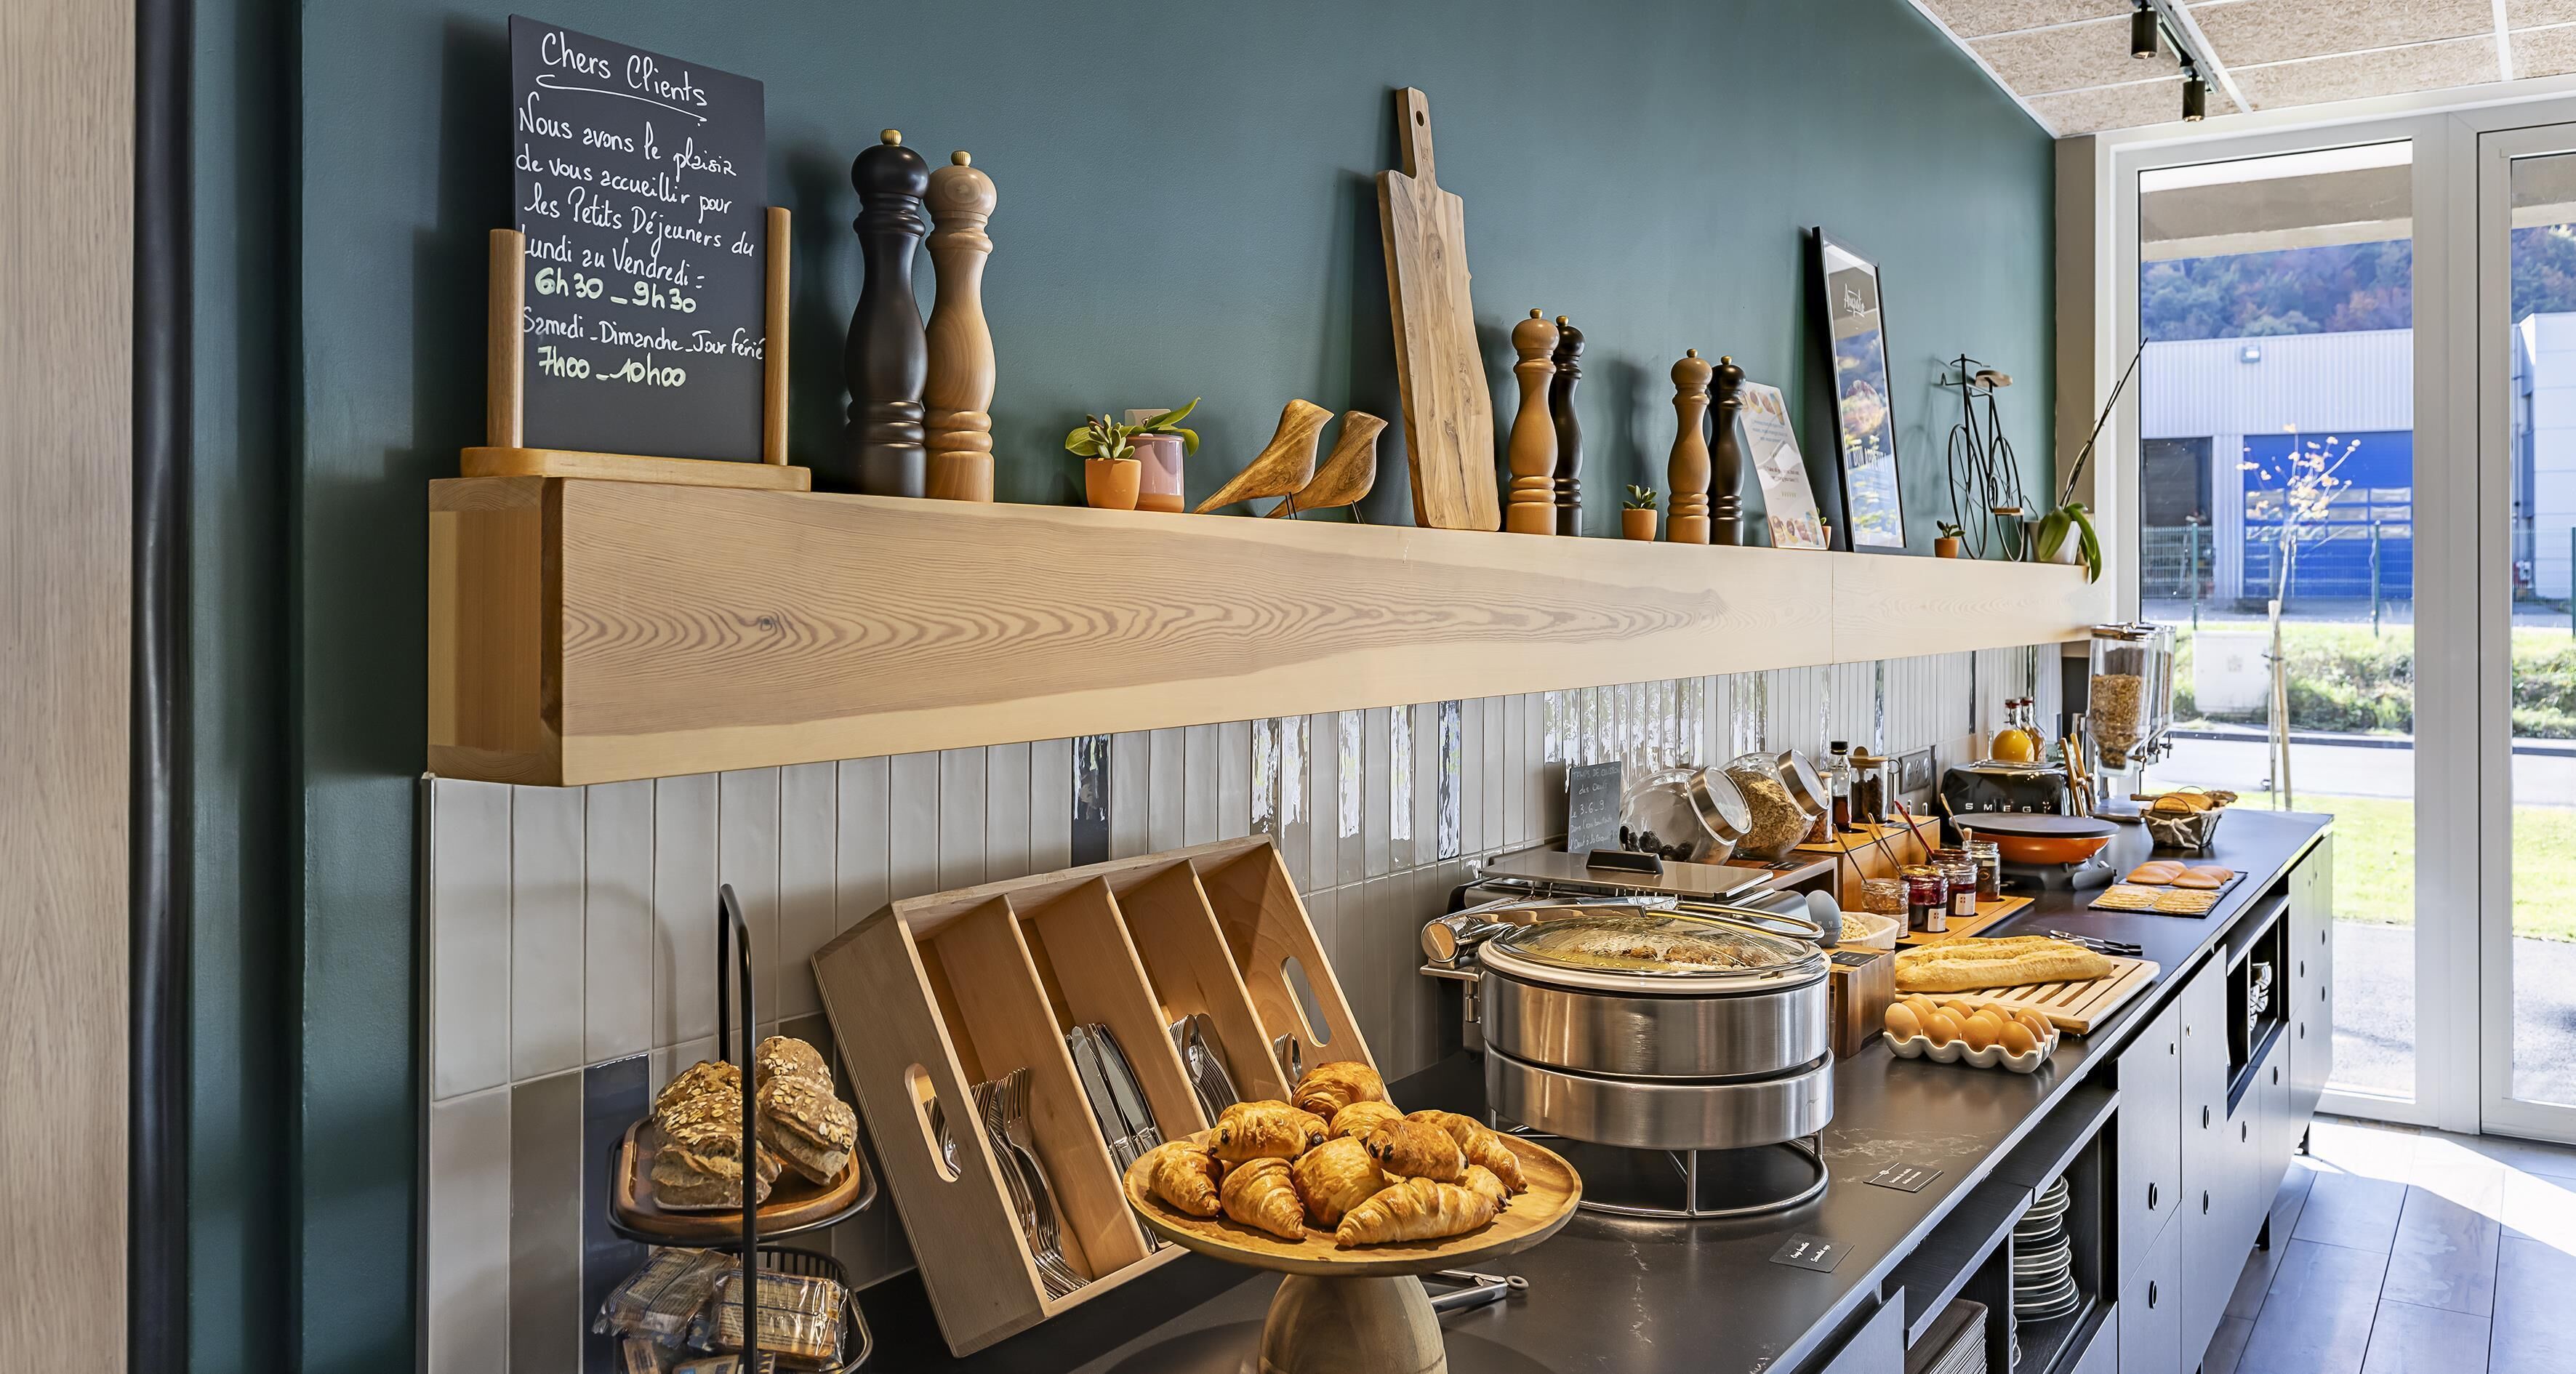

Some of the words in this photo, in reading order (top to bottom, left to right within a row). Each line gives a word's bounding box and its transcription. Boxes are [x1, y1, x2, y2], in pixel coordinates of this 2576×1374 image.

[542, 31, 611, 79] Chers
[627, 55, 707, 107] Clients
[519, 91, 573, 139] Nous
[582, 126, 635, 153] avons
[644, 121, 661, 161] le
[516, 143, 543, 172] de
[548, 159, 593, 181] vous
[601, 170, 691, 205] accueillir
[699, 195, 733, 224] pour
[523, 182, 561, 218] les
[568, 186, 623, 230] Petits
[632, 206, 722, 259] Déjeuners
[731, 231, 755, 257] du
[582, 249, 606, 268] au
[613, 238, 689, 288] Vendredi
[523, 306, 584, 338] Samedi
[1965, 803, 2031, 813] SMEG
